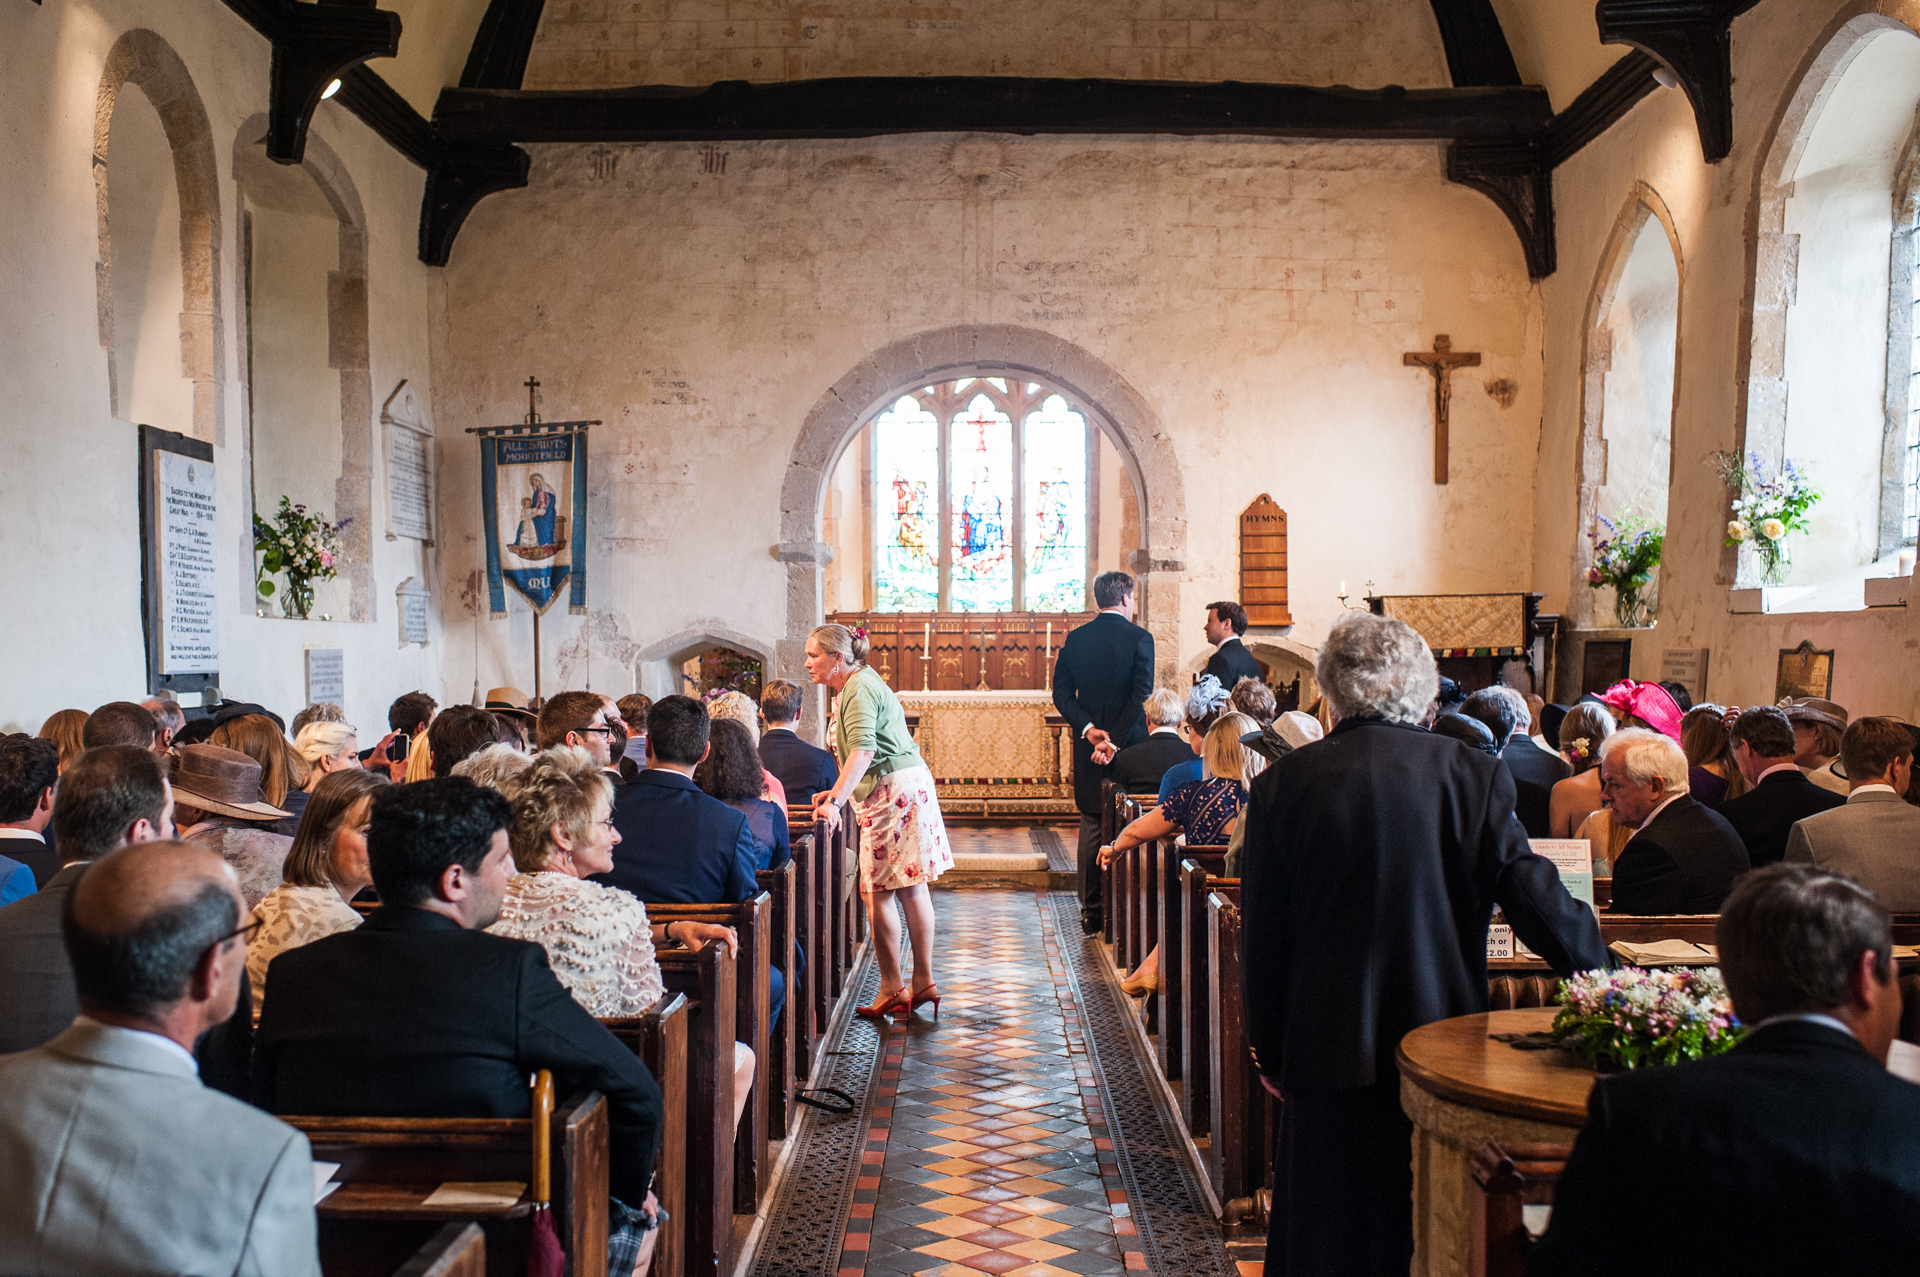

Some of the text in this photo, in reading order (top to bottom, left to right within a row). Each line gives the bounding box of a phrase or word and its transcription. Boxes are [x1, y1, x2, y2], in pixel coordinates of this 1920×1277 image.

[503, 439, 568, 454] ALL SAINTS
[506, 450, 567, 463] MOUNTFIELD
[1250, 517, 1300, 526] HYMNS
[527, 576, 550, 590] MU
